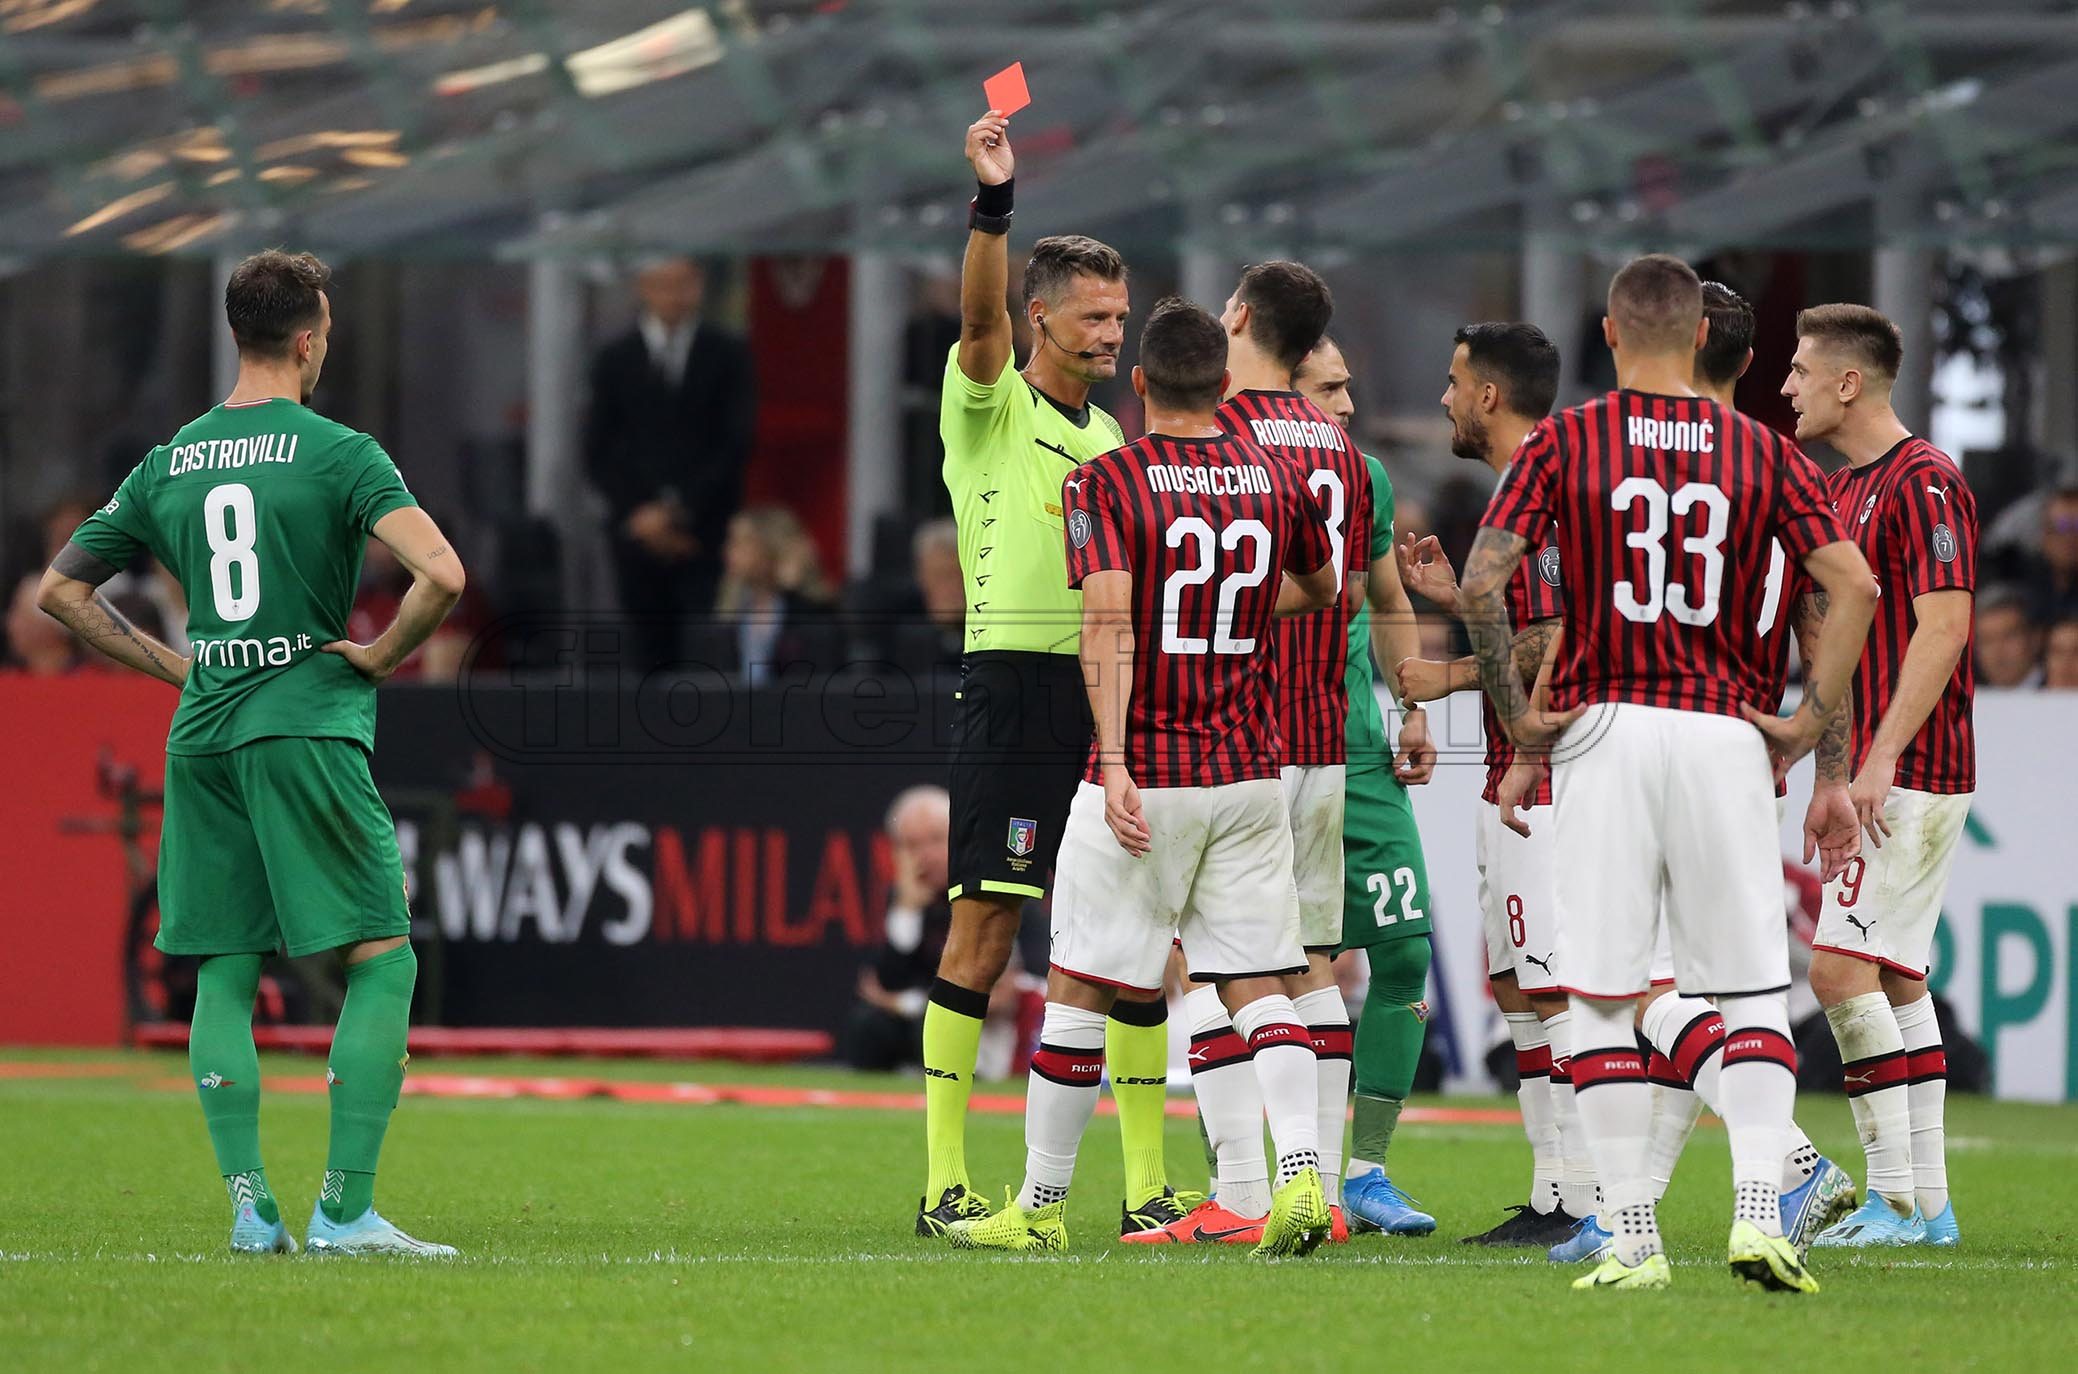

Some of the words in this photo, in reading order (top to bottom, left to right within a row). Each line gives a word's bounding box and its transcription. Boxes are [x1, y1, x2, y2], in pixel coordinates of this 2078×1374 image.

[168, 433, 298, 477] CASTROVILLI
[1249, 418, 1346, 453] ROMAGNOLI
[1628, 415, 1715, 453] KRUNIĆ
[1146, 464, 1272, 496] MUSACCHIO
[203, 483, 260, 622] 8
[1611, 475, 1731, 628] 33
[1161, 516, 1272, 655] 22
[1366, 866, 1424, 928] 22
[1837, 855, 1866, 908] 9
[1506, 894, 1527, 948] 8
[1707, 1022, 1726, 1035] AC
[1116, 1077, 1167, 1085] LEGE
